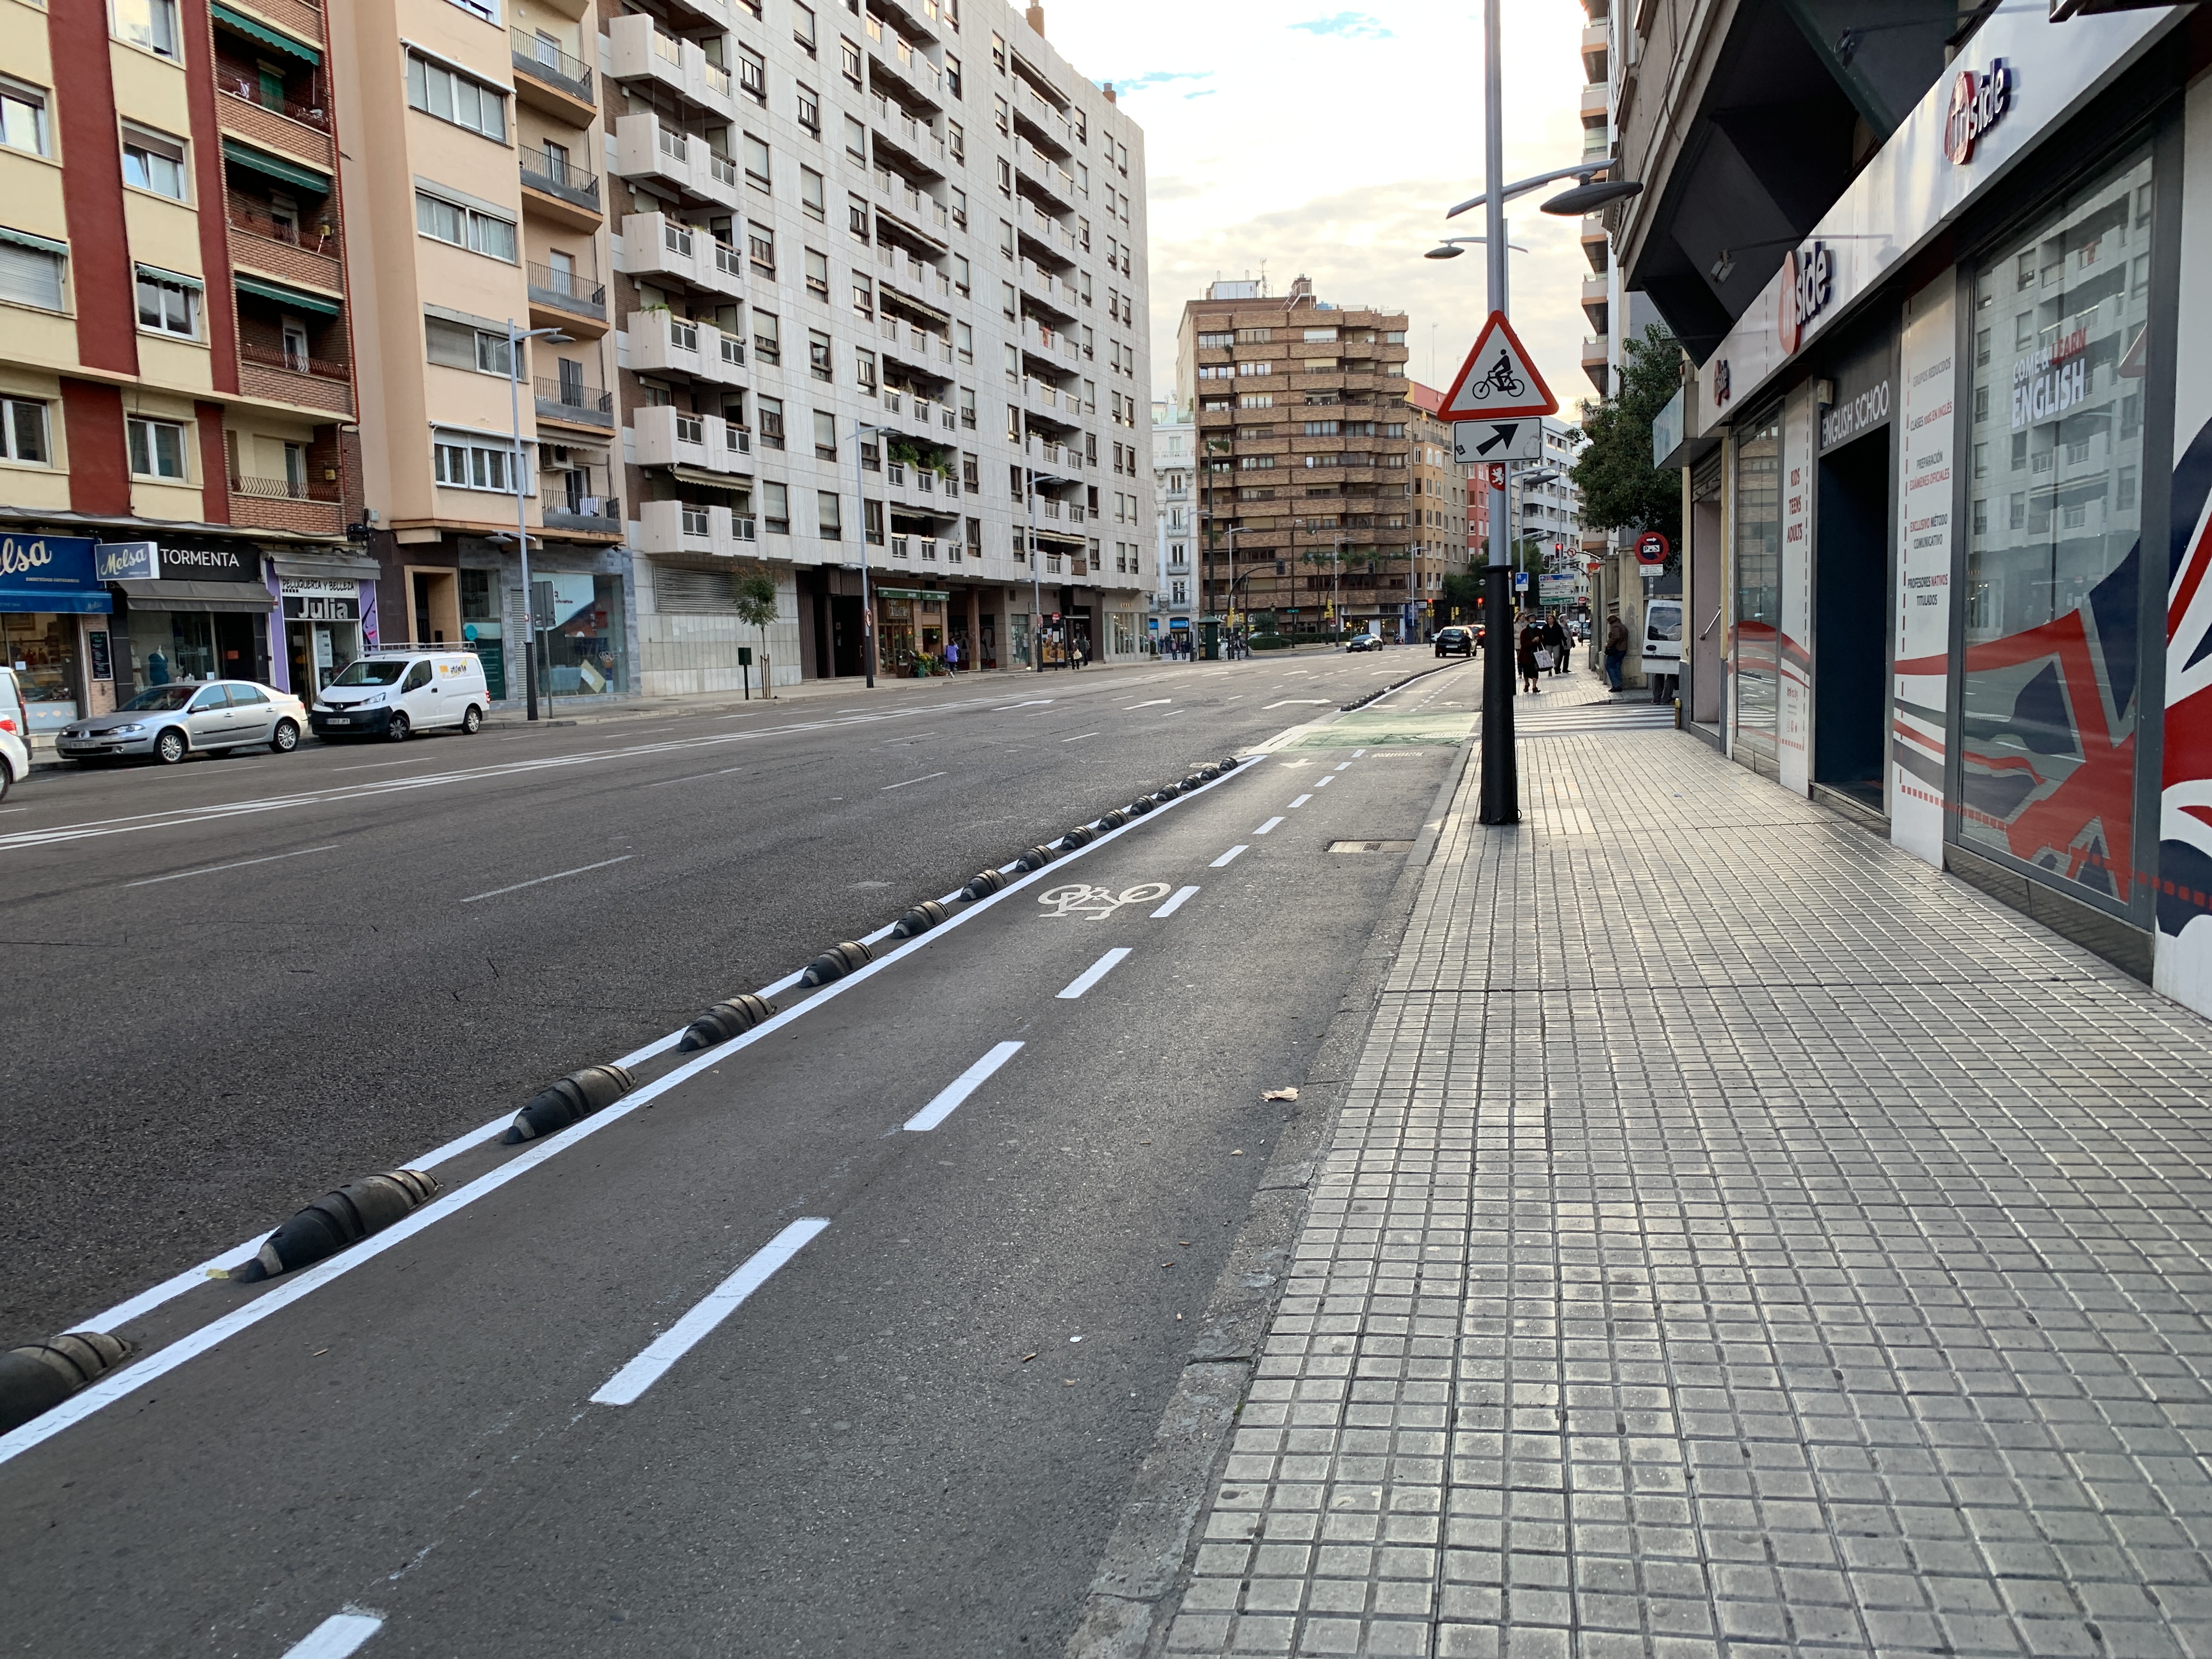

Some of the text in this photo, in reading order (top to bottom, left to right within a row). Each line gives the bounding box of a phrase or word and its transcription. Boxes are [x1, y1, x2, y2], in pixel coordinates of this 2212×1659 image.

[1782, 241, 1831, 340] inside
[2013, 328, 2086, 383] COME & LEARN
[1913, 357, 1951, 387] GRUPOS REDUCIDOS
[2012, 358, 2085, 428] ENGLISH
[1822, 380, 1890, 448] ENGLISH SCHOO
[1910, 416, 1923, 431] CLASES
[1932, 409, 1938, 421] EN
[1938, 399, 1952, 419] INGLÉS
[1917, 449, 1943, 470] PREPARACIÓN
[1791, 467, 1800, 487] KIDS
[1910, 467, 1950, 490] EXÁMENES OFICIALES
[1788, 495, 1801, 515] TEENS
[1786, 523, 1803, 543] ADULTS
[1910, 514, 1948, 532] EXCLUSIVO MÉTODO
[1914, 534, 1943, 549] COMUNICATIVO
[100, 549, 147, 576] Melsa
[160, 549, 240, 568] TORMENTA
[324, 582, 328, 591] Y
[329, 581, 355, 591] BELLEZA
[1908, 574, 1948, 589] PROFESORES NATIVOS
[297, 597, 348, 619] Julia
[1917, 594, 1937, 606] TITULADOS
